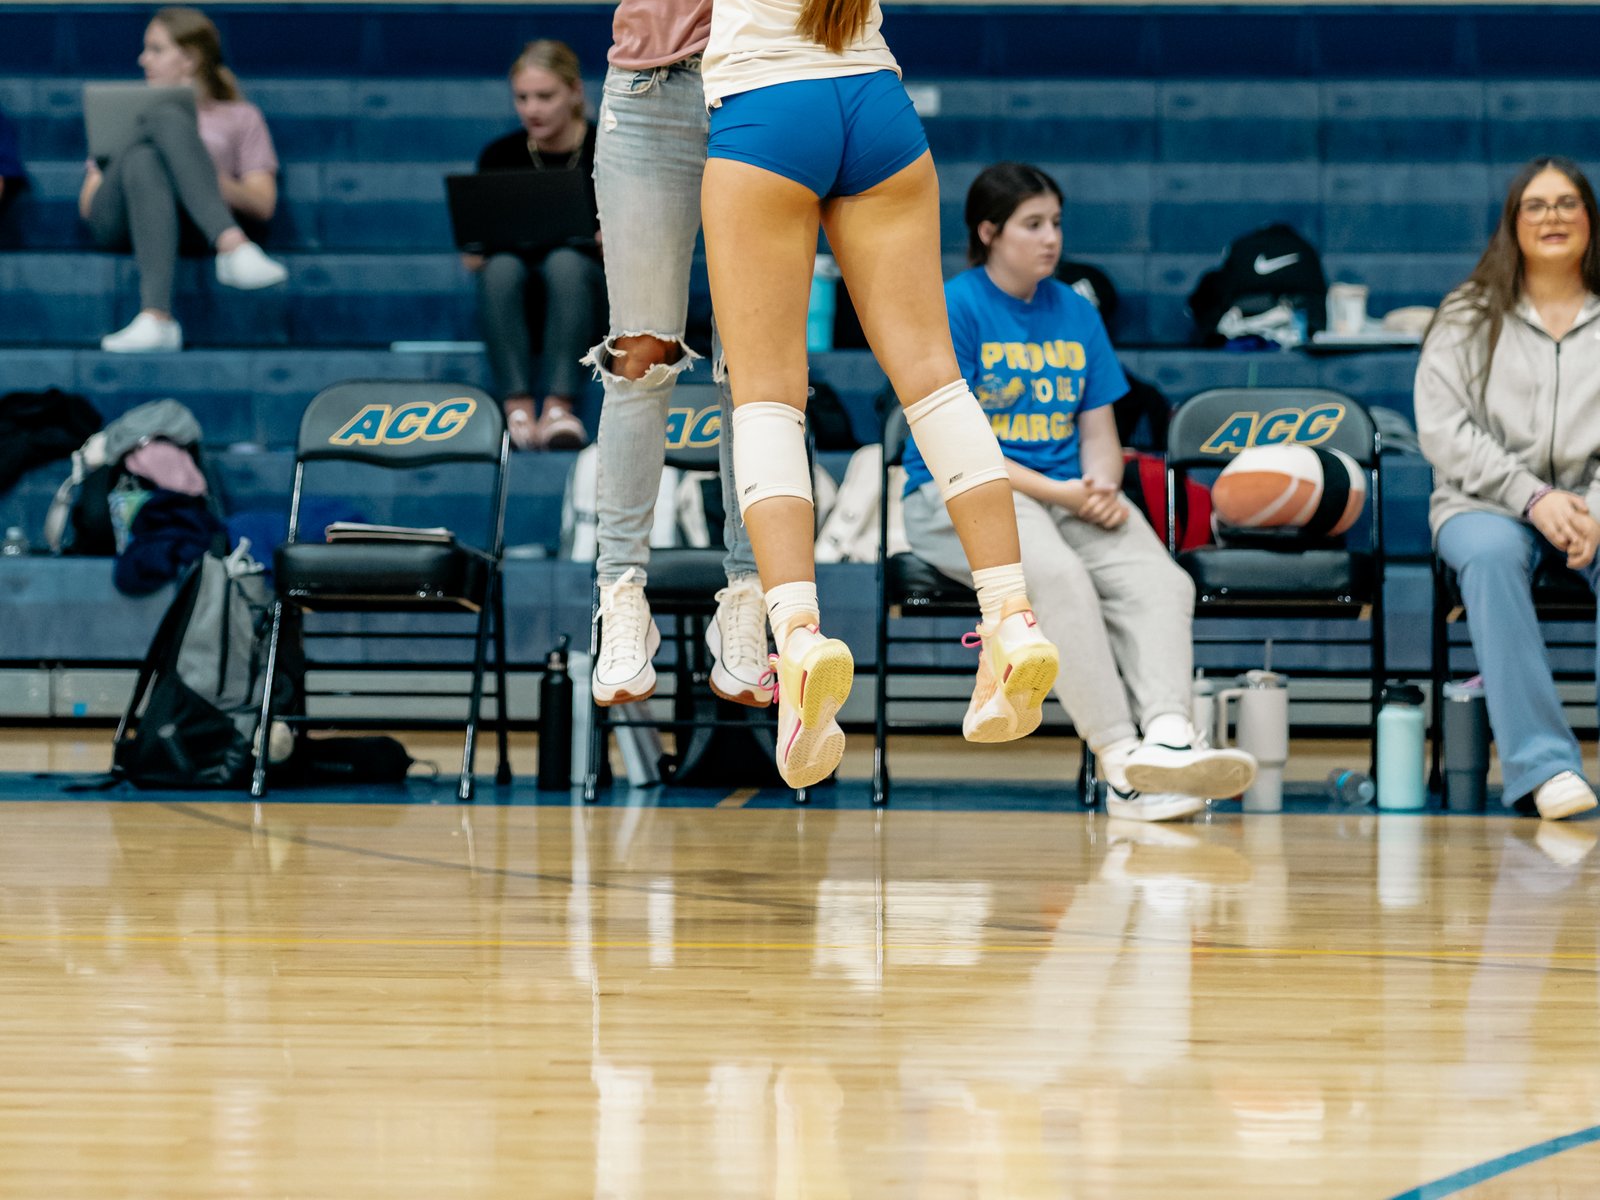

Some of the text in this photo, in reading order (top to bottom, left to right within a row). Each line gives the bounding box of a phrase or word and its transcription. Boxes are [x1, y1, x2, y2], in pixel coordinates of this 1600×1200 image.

[981, 340, 1086, 372] PROUD
[329, 397, 477, 446] ACC
[986, 412, 1074, 442] HARG
[1200, 402, 1346, 454] ACC
